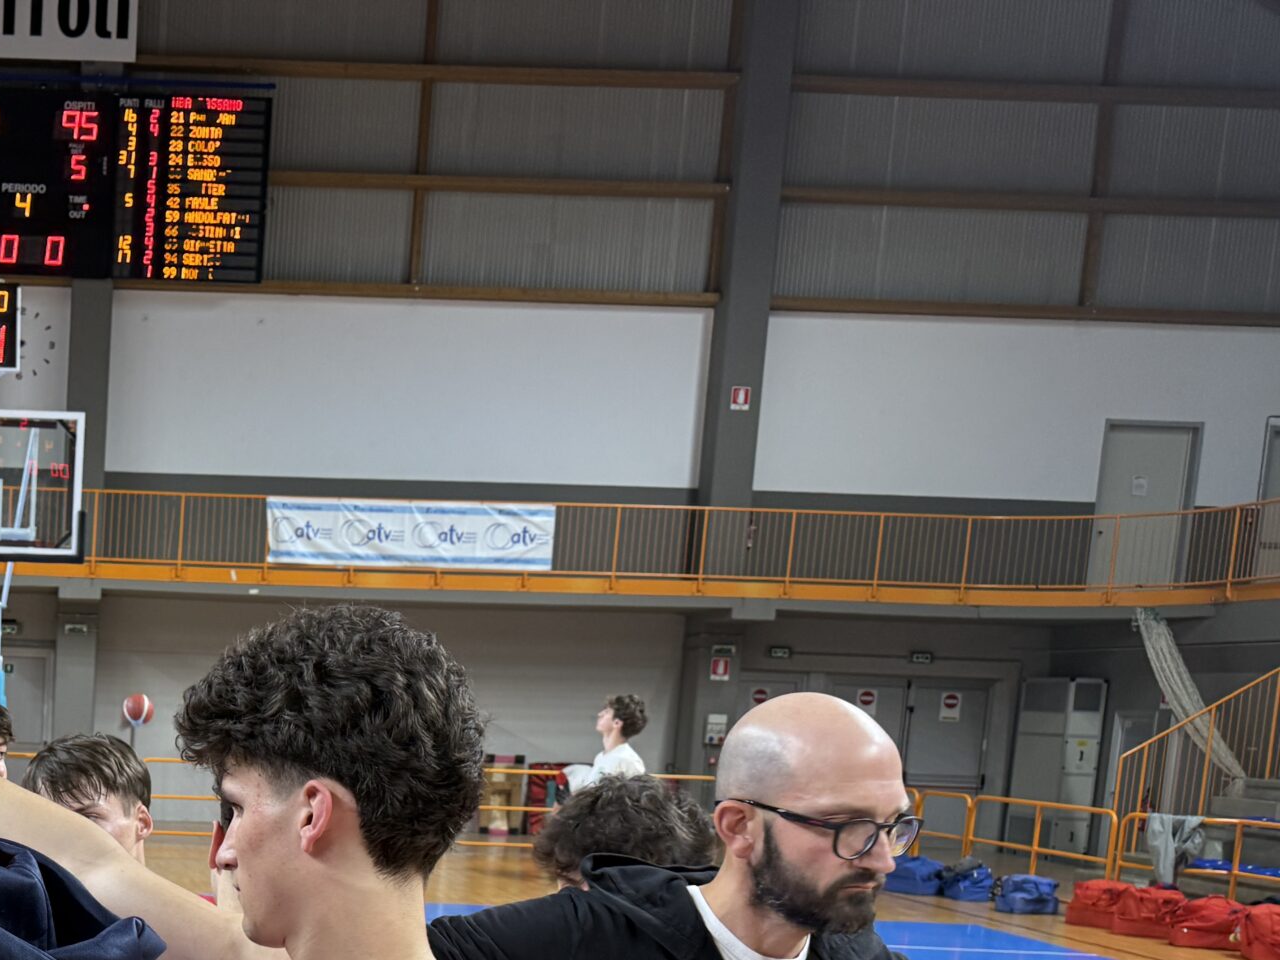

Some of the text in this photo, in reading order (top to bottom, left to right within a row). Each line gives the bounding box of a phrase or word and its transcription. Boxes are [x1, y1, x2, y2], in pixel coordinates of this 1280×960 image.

[64, 101, 96, 110] OSPITI
[124, 108, 137, 122] 16
[150, 109, 160, 122] 2
[170, 112, 184, 123] 21
[62, 110, 99, 140] 95
[128, 123, 136, 135] 4
[150, 124, 159, 136] 4
[170, 126, 184, 137] 22
[128, 136, 136, 150] 3
[118, 150, 135, 164] 31
[149, 152, 158, 166] 3
[168, 154, 182, 166] 24
[71, 155, 86, 180] 5
[127, 165, 135, 178] 7
[152, 166, 157, 179] 1
[1, 183, 46, 194] PERIODO
[147, 180, 156, 193] 5
[15, 192, 32, 217] 4
[125, 193, 133, 207] 5
[147, 194, 155, 207] 4
[167, 197, 180, 208] 42
[68, 210, 86, 218] OUT
[145, 208, 155, 221] 2
[165, 210, 180, 222] 59
[145, 222, 154, 236] 3
[119, 235, 132, 250] 12
[145, 237, 153, 249] 4
[44, 236, 65, 266] 0
[118, 250, 131, 263] 17
[143, 250, 153, 264] 2
[147, 265, 152, 278] 1
[163, 267, 177, 279] 99
